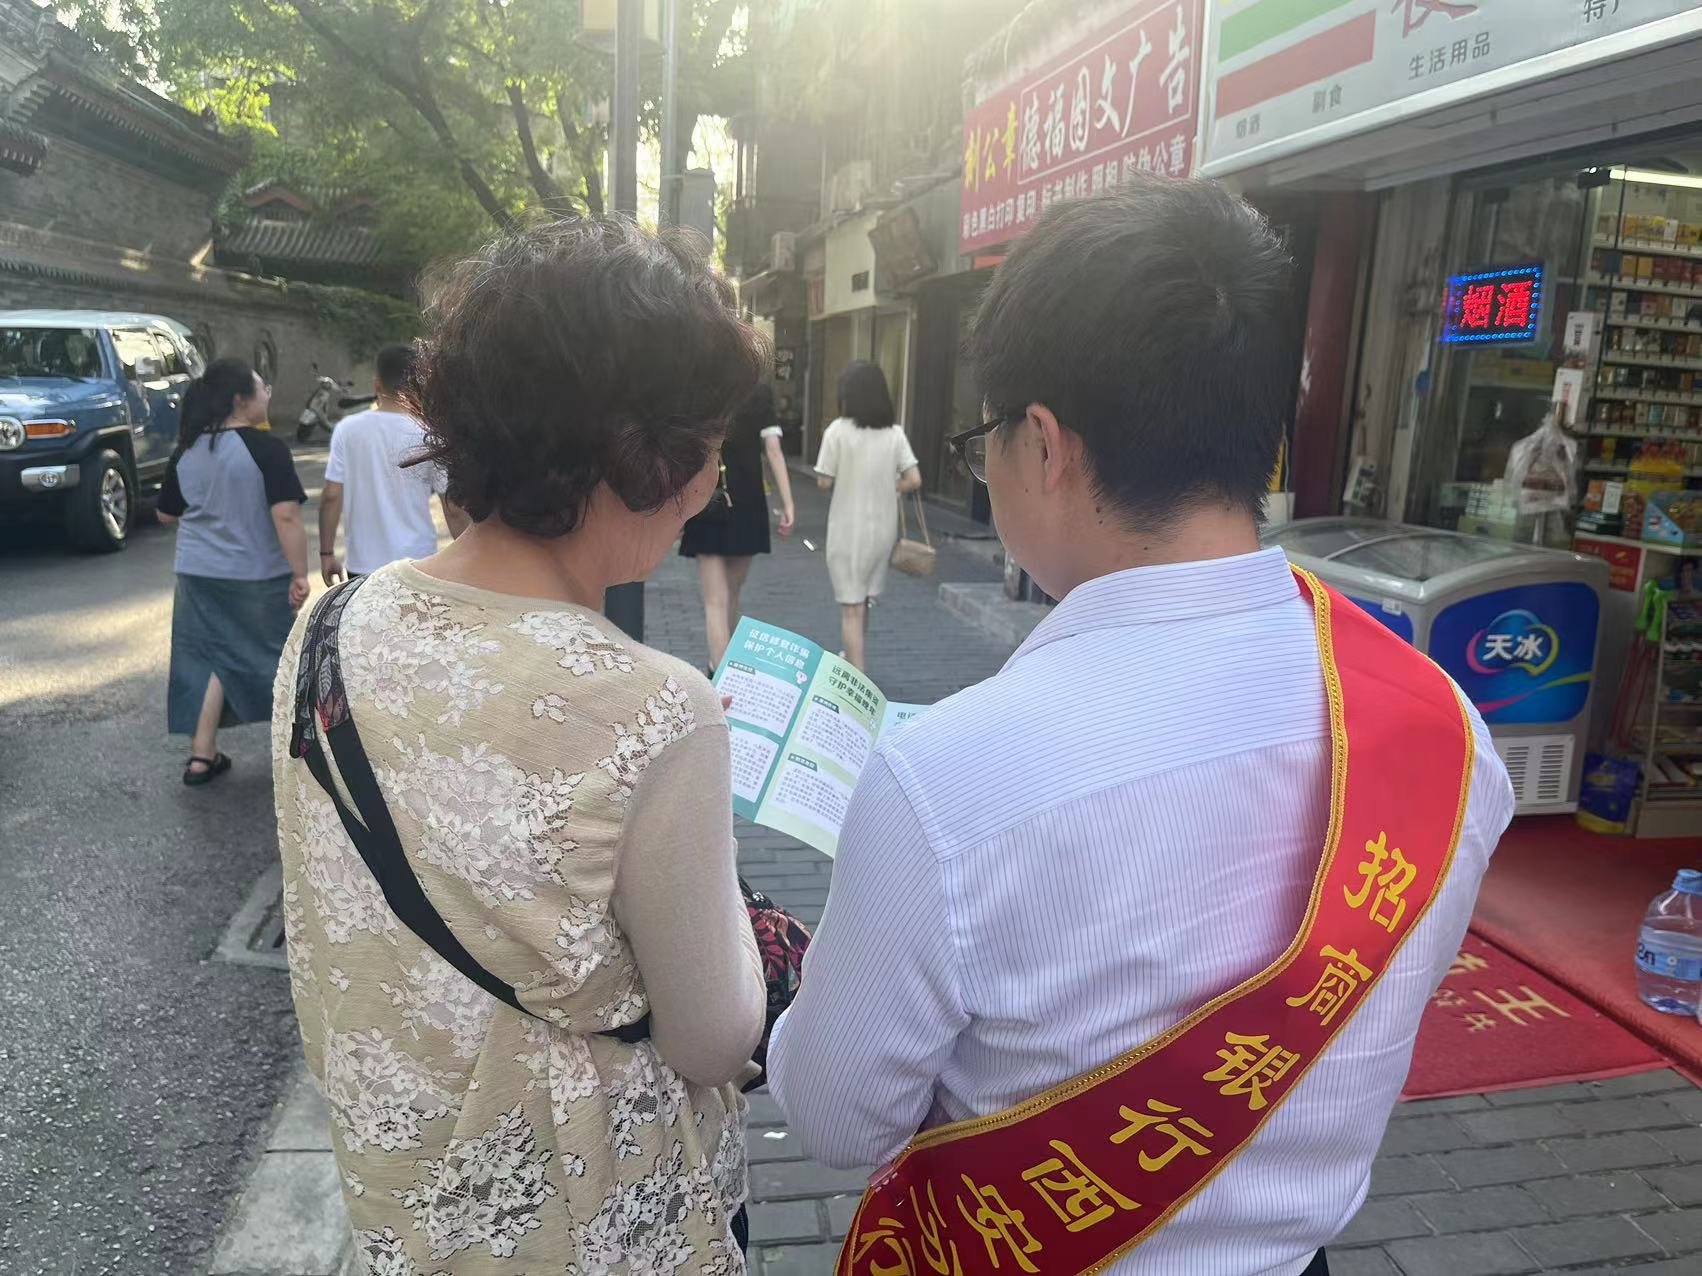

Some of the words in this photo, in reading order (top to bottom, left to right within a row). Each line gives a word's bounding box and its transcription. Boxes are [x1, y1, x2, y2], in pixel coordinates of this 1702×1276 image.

[1408, 31, 1490, 80] 生活用品
[1461, 280, 1533, 328] 烟酒
[1483, 633, 1542, 661] 天冰
